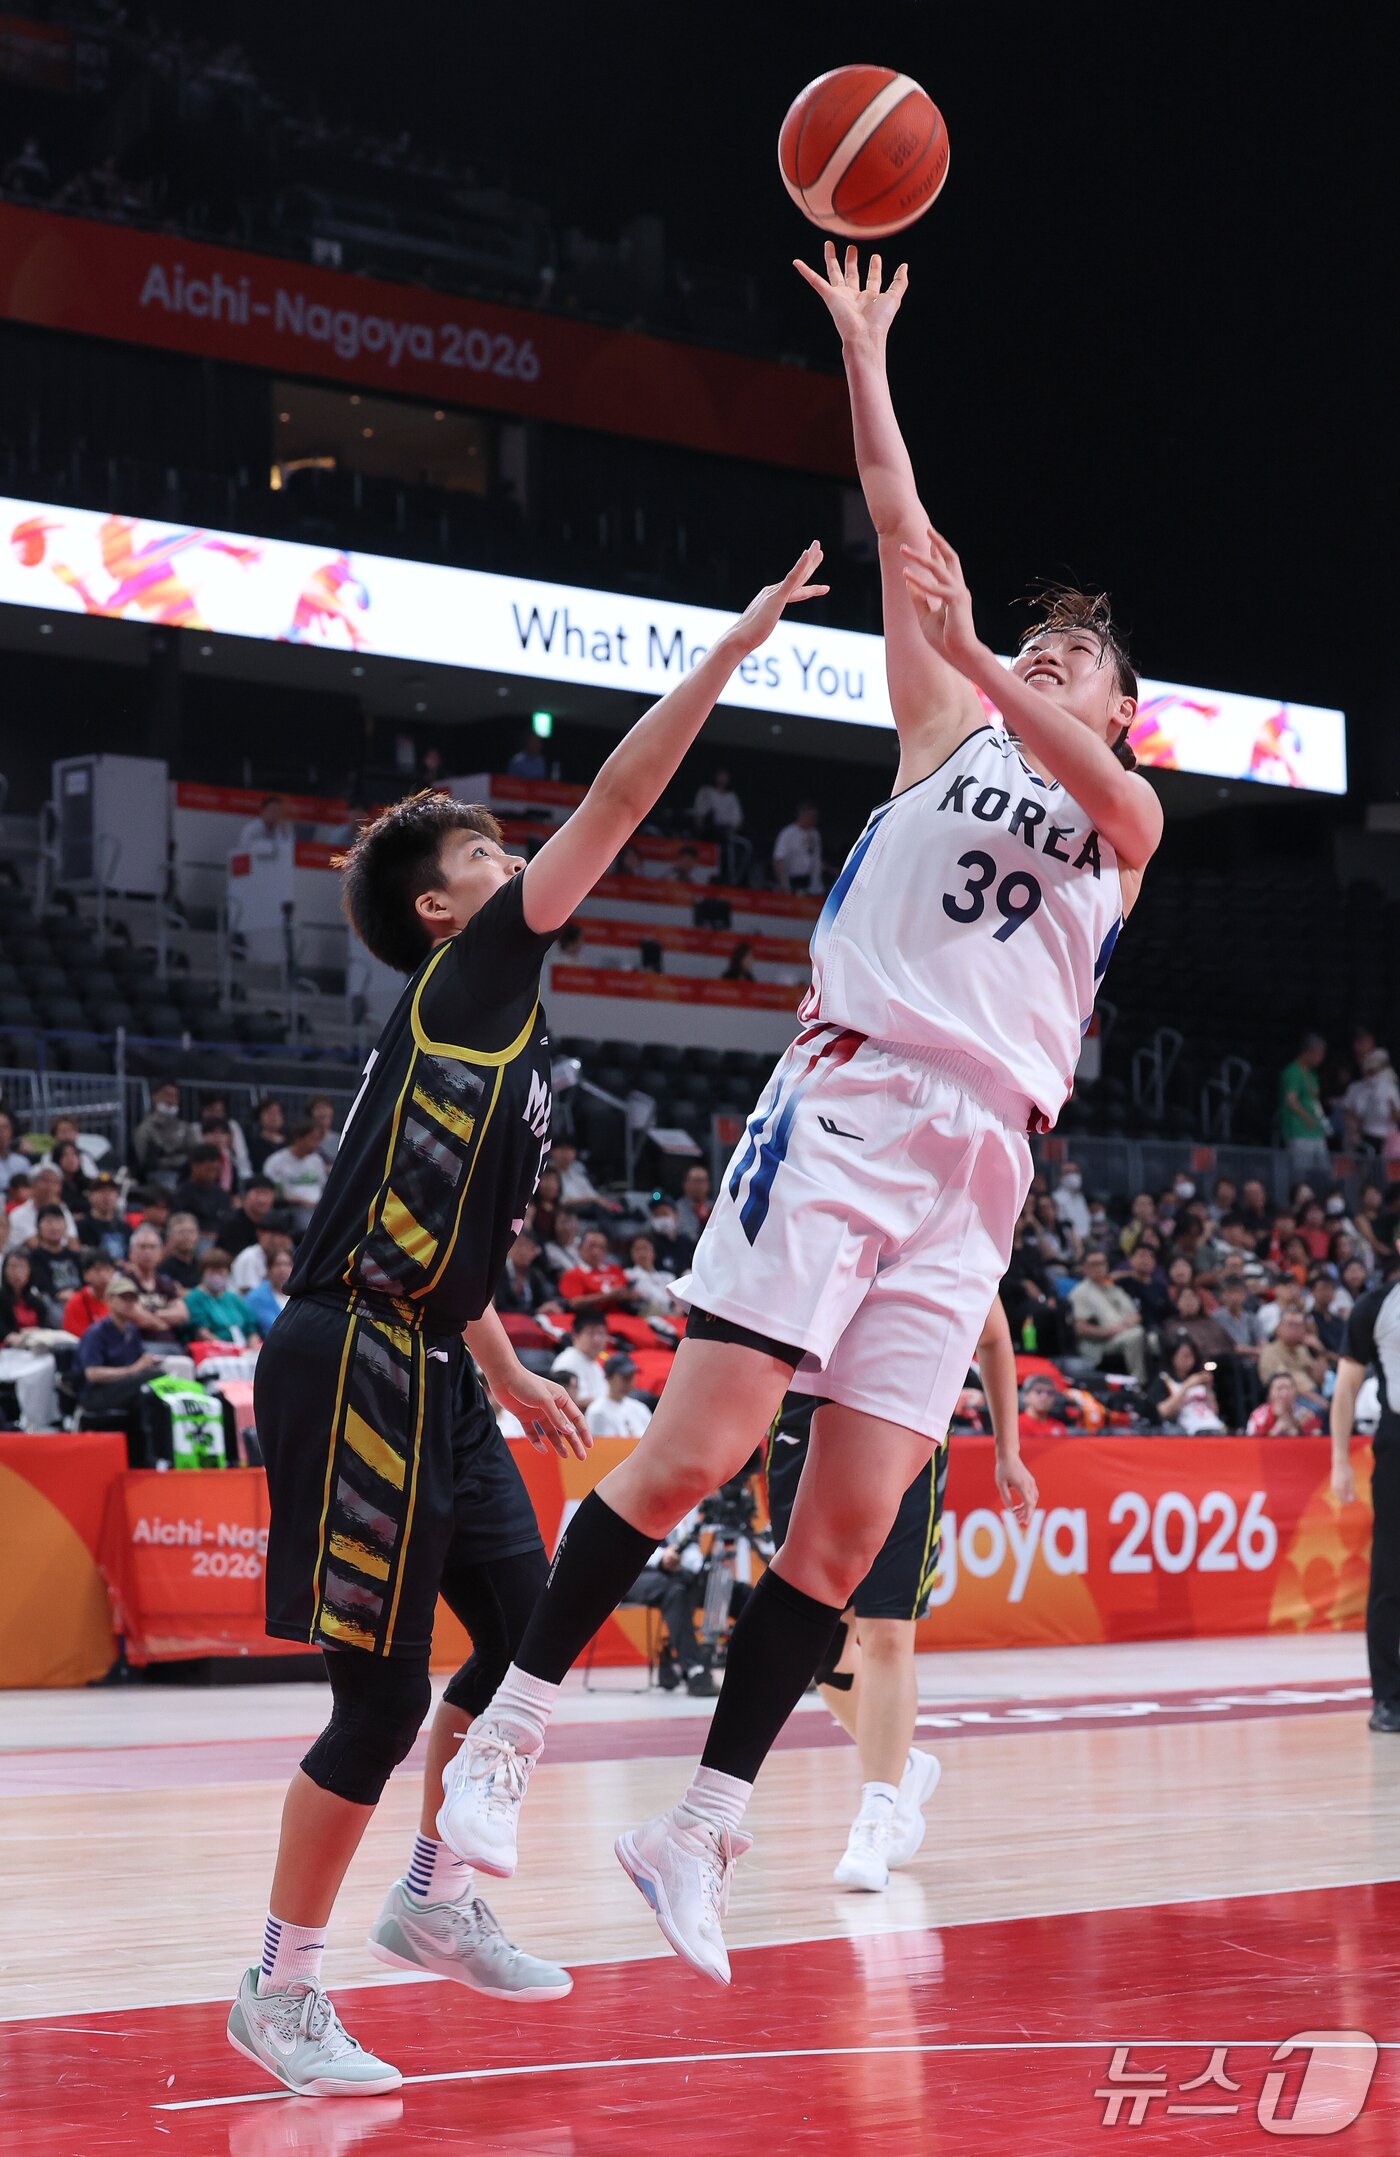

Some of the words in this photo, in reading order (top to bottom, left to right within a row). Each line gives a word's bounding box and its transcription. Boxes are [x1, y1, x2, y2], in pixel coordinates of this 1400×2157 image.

[139, 263, 433, 367] Aichi-Nagoya
[437, 323, 540, 382] 2026
[512, 602, 630, 667] What
[791, 645, 865, 700] You
[937, 775, 1102, 880] KOREA
[942, 850, 1042, 943] 39
[191, 1551, 262, 1581] 2026
[1109, 1491, 1278, 1574] 2026
